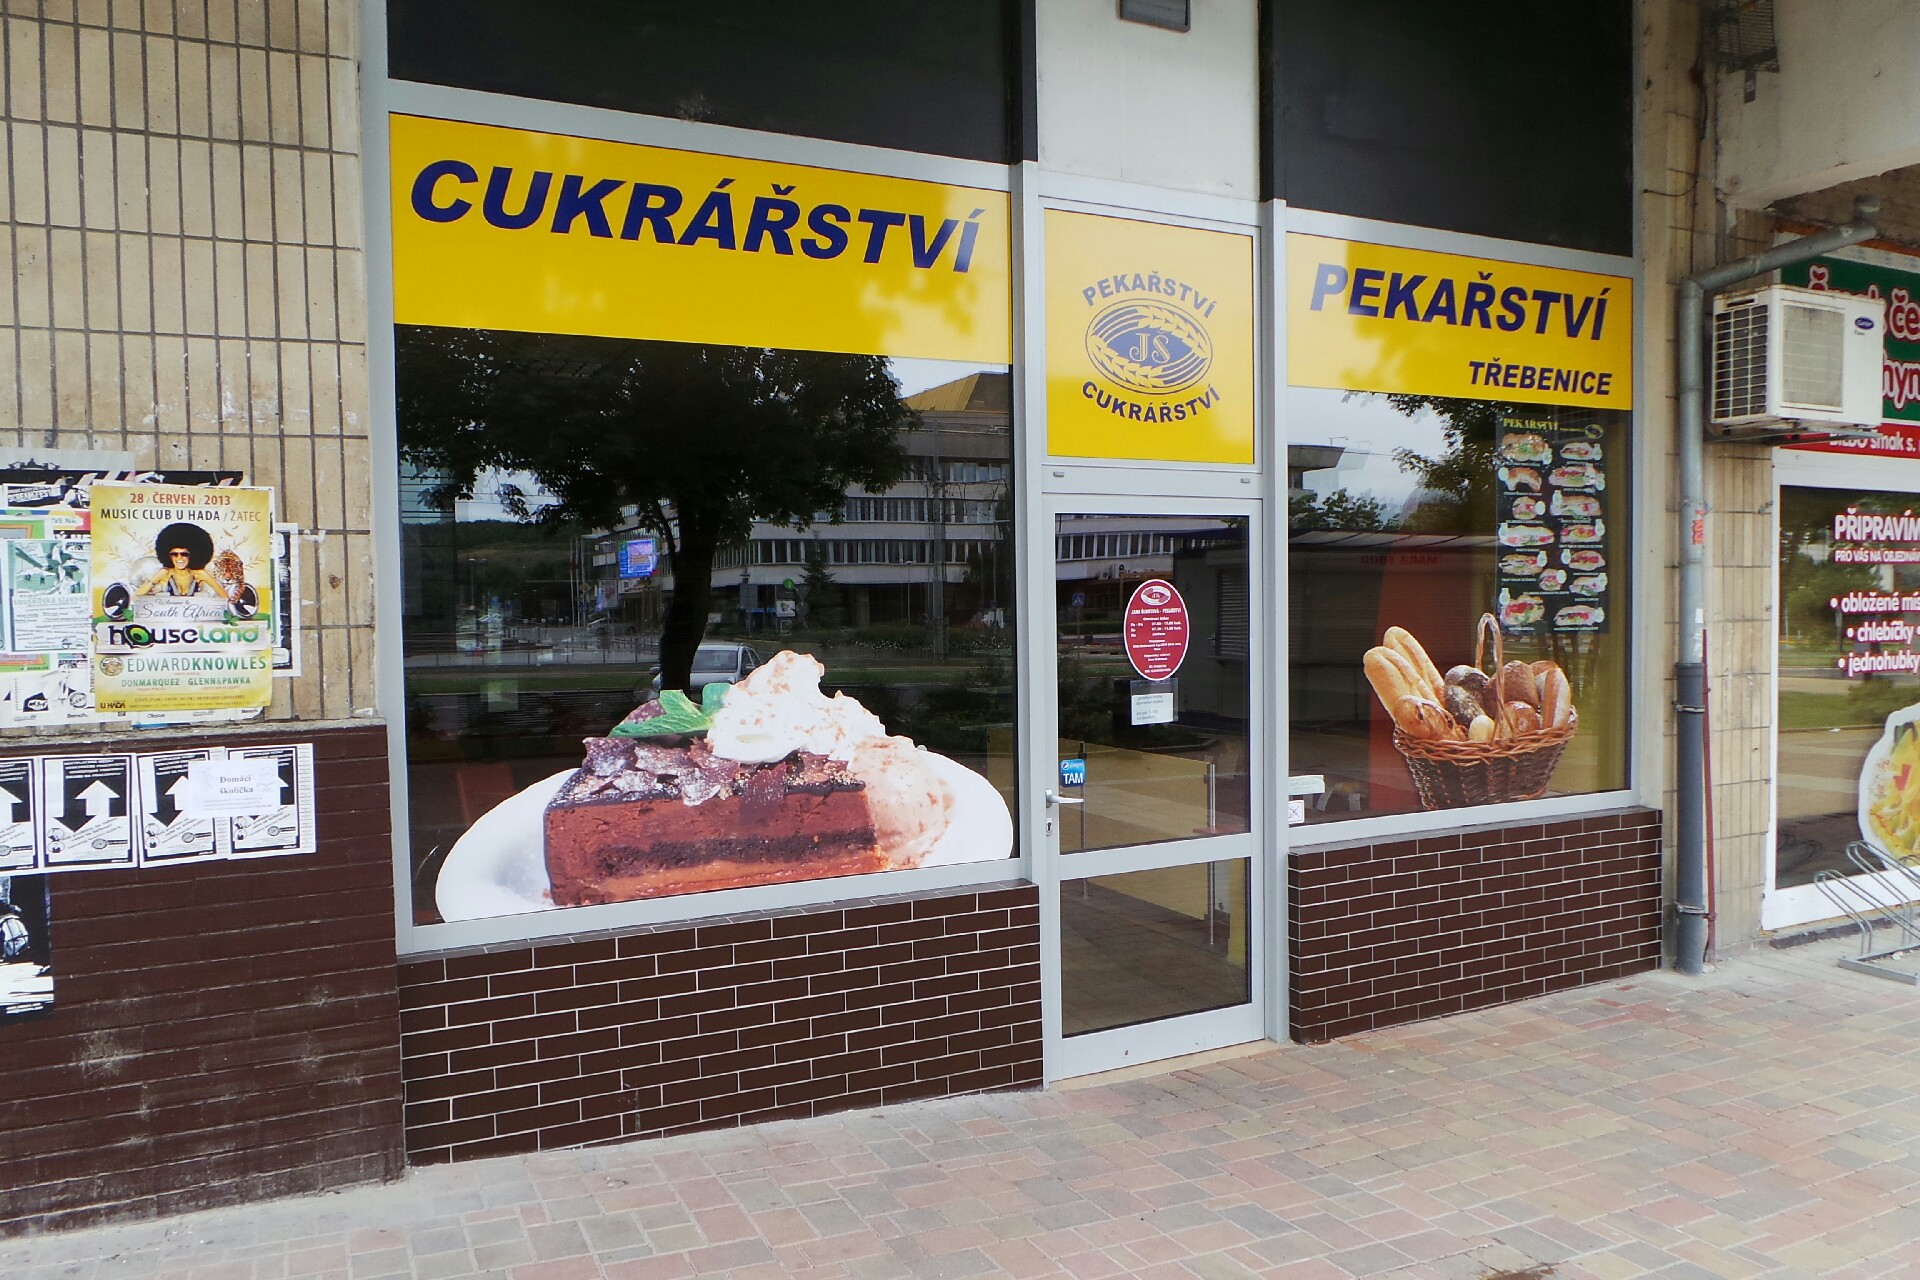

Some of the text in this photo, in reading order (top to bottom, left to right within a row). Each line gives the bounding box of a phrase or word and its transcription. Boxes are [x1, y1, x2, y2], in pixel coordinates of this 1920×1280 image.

[410, 159, 986, 274] CUKRÁŘSTVÍ
[1082, 270, 1217, 318] PEKAŘSTVÍ
[1310, 263, 1611, 341] PEKAŘSTVÍ
[1129, 332, 1171, 364] JŠ
[1468, 357, 1613, 396] TŘEBENICE
[1082, 381, 1221, 423] CUKRÁŘSTVÍ
[130, 493, 144, 504] 28
[152, 491, 196, 506] ČERVEN
[204, 494, 231, 506] 2013
[100, 508, 138, 520] MUSIC
[142, 509, 172, 520] CLUB
[176, 509, 184, 520] U
[188, 510, 221, 521] HADA
[229, 510, 261, 522] ŽATEC
[1835, 551, 1852, 562] PRO
[1854, 548, 1869, 562] VÁS
[1870, 551, 1882, 562] NA
[137, 603, 221, 621] South Africa
[1841, 592, 1899, 612] obložené
[1857, 620, 1914, 644] chlebíčky
[127, 656, 267, 673] EDWARDKNOWLES
[1848, 650, 1920, 677] jednohubky
[121, 678, 180, 688] DONMARQUEZ
[1063, 772, 1083, 785] TAM
